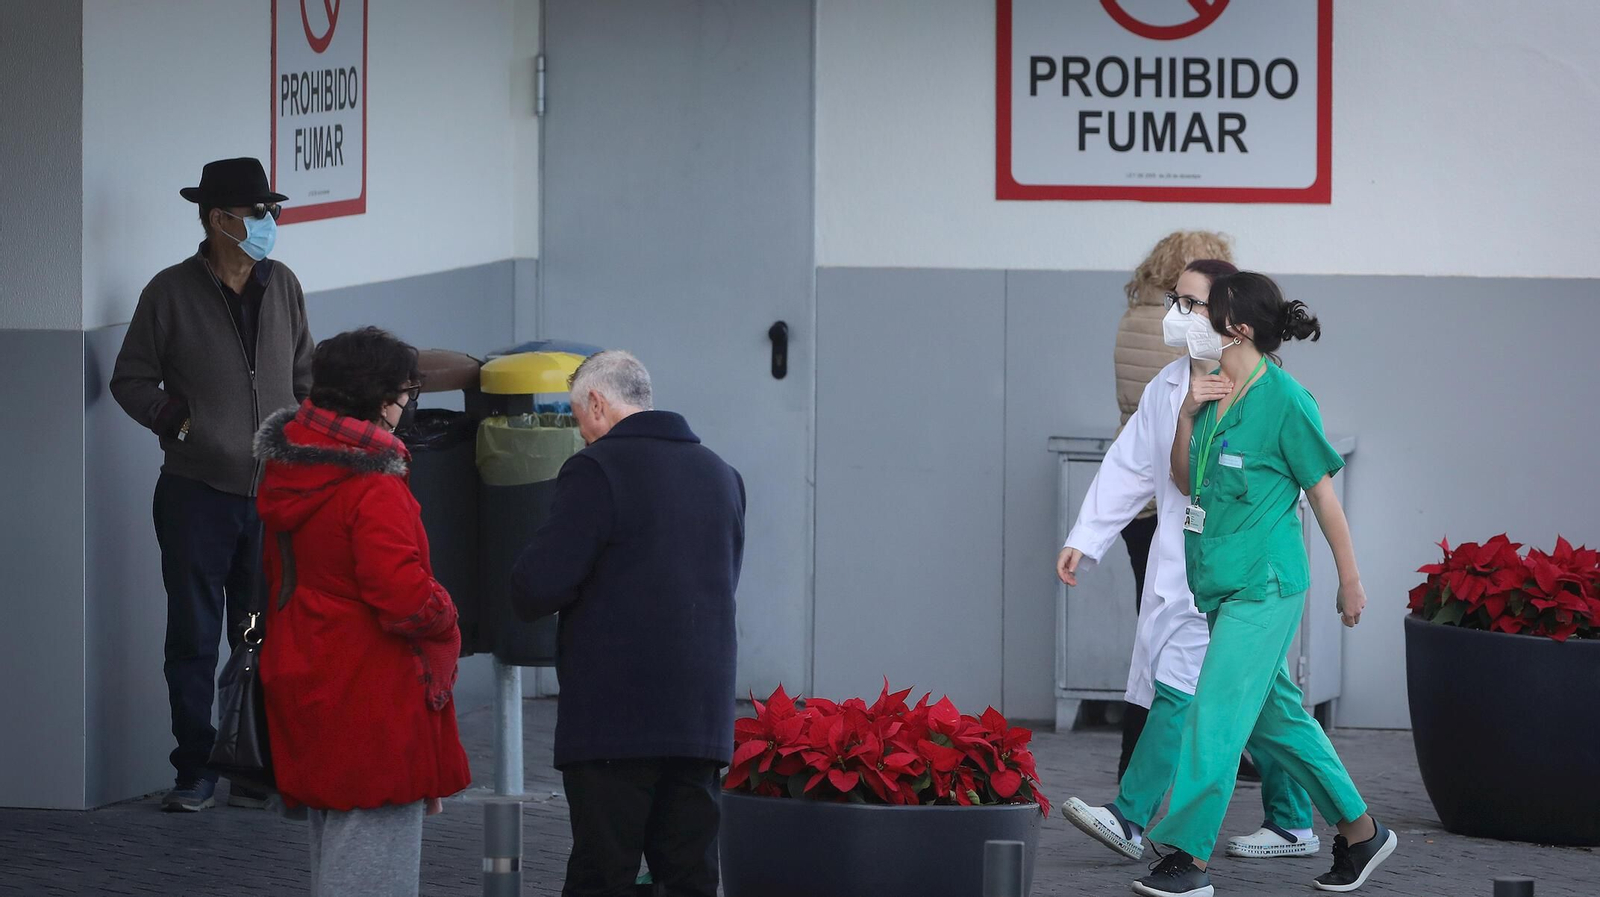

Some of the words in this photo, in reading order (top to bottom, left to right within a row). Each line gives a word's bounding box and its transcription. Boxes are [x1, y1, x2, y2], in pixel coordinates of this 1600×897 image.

[281, 66, 358, 117] PROHIBIDO
[1029, 55, 1299, 100] PROHIBIDO
[295, 124, 344, 171] FUMAR
[1078, 110, 1249, 154] FUMAR
